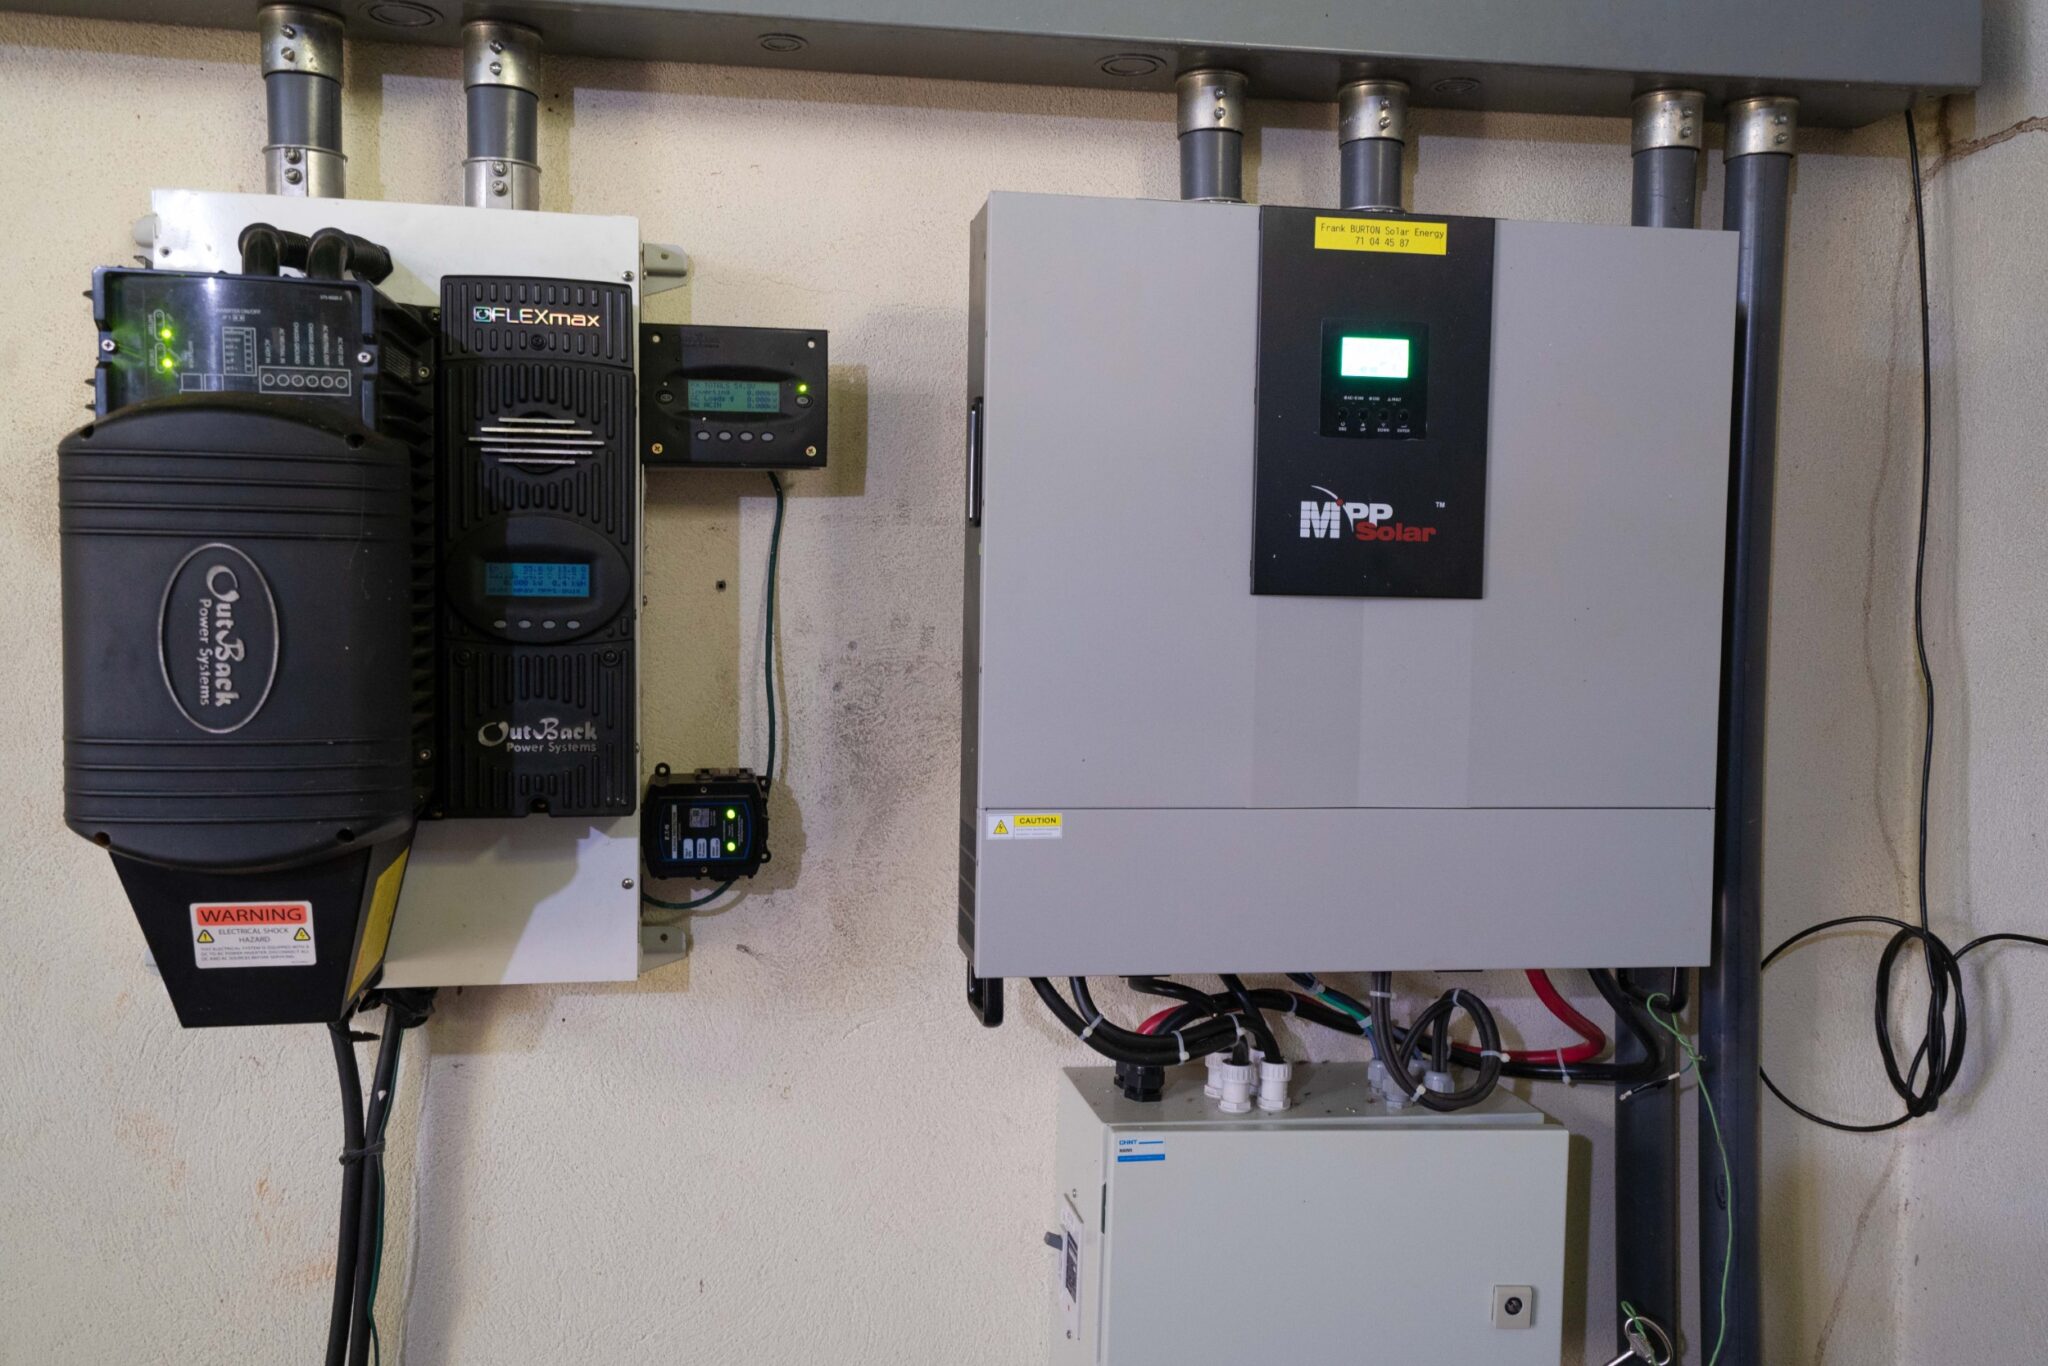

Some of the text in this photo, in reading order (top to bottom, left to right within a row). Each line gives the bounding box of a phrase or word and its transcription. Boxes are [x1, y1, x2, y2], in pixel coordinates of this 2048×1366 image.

[1320, 222, 1445, 239] Frank BURTON Solar Energy
[1355, 236, 1410, 247] 71 04 45 87
[492, 307, 600, 327] FLEXmax
[1300, 500, 1393, 539] MPP
[1356, 521, 1437, 542] Solar
[206, 565, 245, 707] OutBack
[195, 599, 212, 706] Power Systems
[478, 717, 598, 747] OutBack
[506, 742, 597, 754] Power Systems
[200, 908, 302, 922] WARNING
